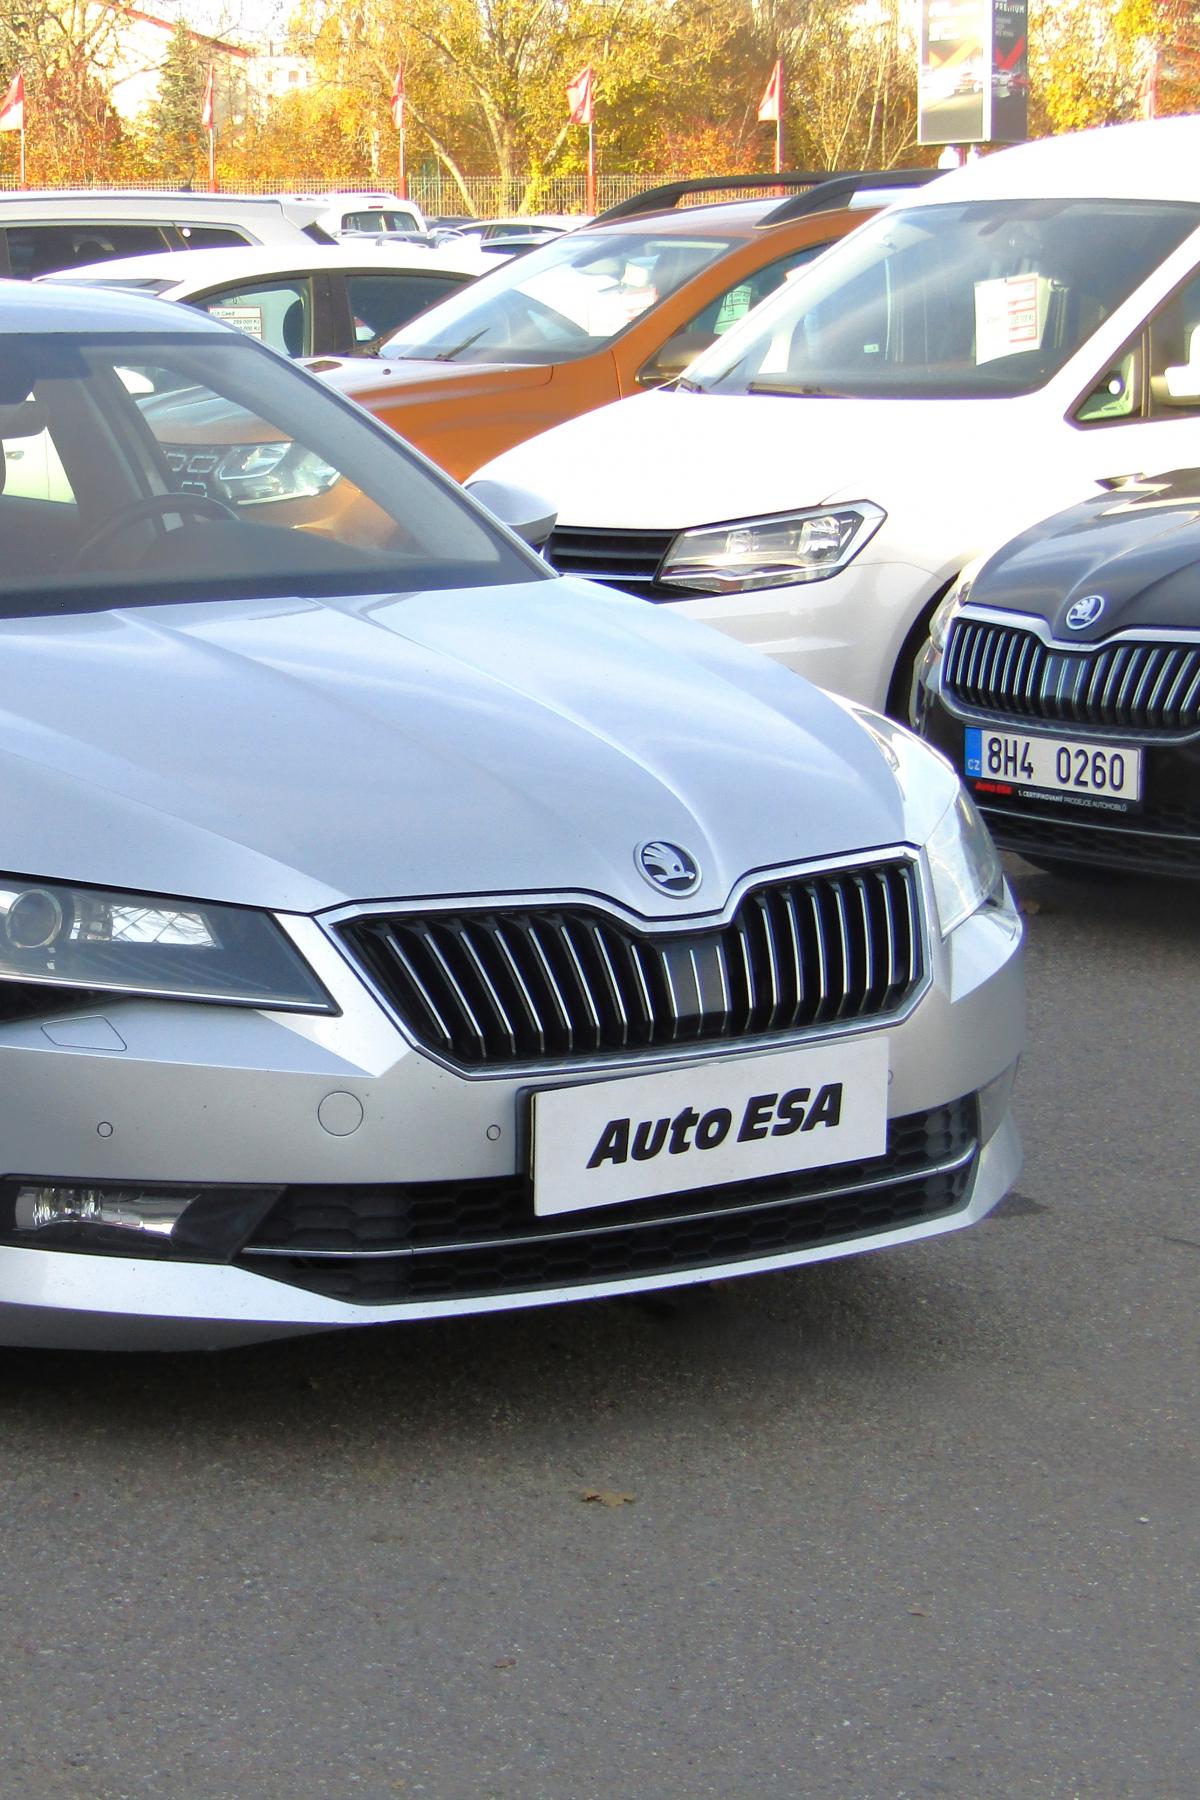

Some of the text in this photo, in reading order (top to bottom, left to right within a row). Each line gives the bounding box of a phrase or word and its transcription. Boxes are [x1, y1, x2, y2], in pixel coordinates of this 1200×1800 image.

[967, 758, 980, 771] CZ
[988, 737, 1125, 792] 8H4 0260
[586, 1082, 843, 1169] Auto ESA
